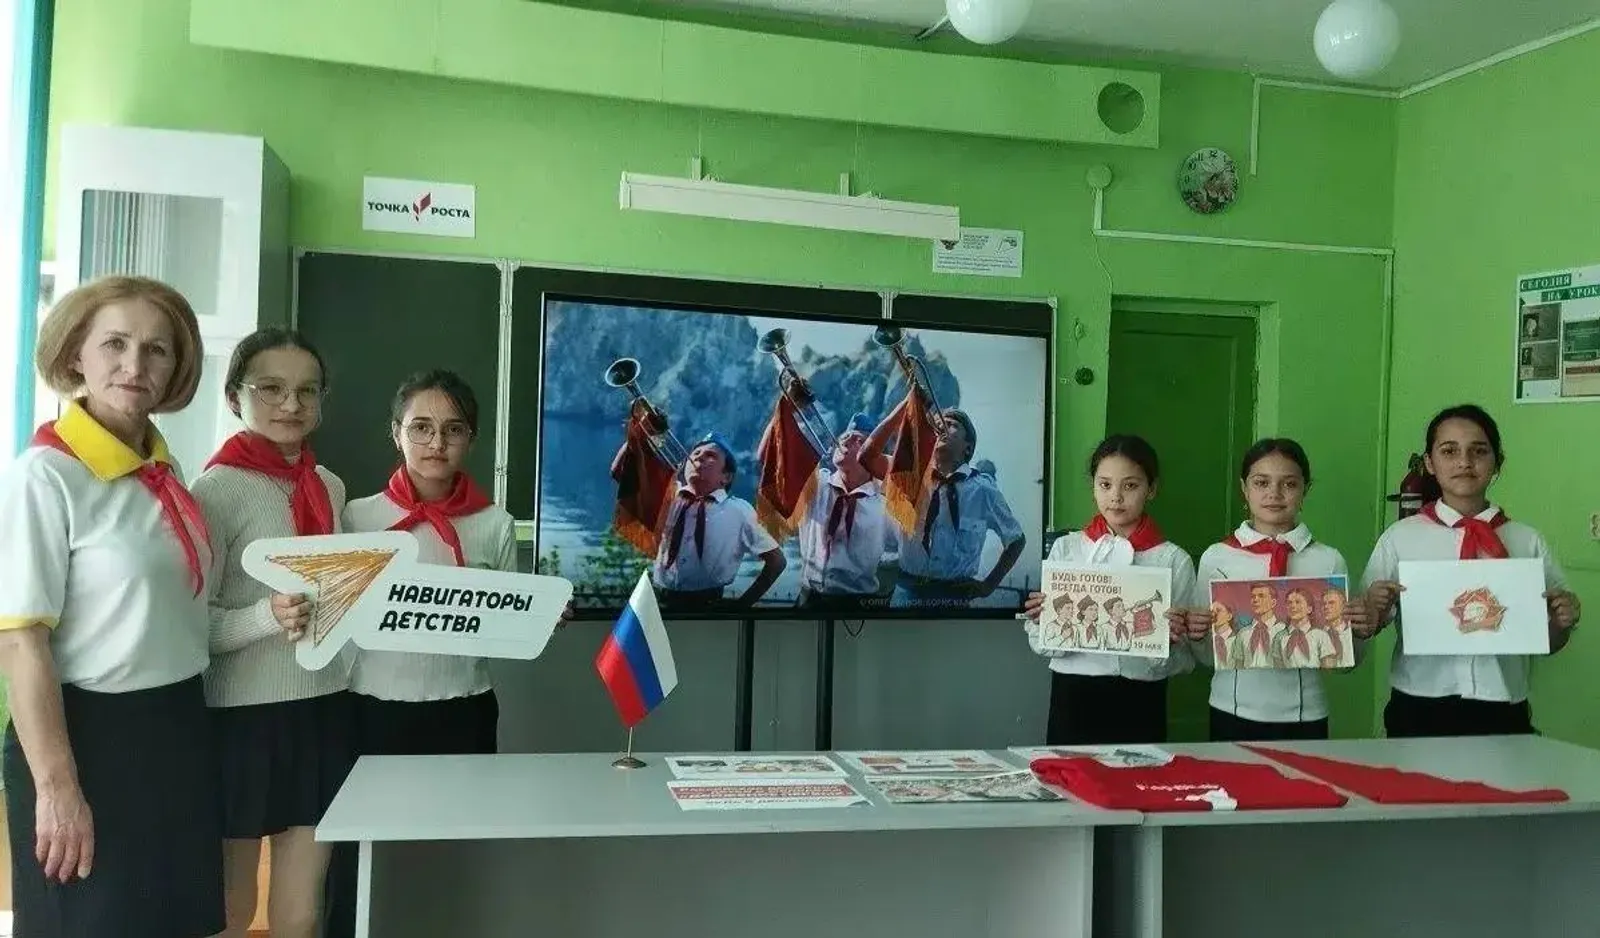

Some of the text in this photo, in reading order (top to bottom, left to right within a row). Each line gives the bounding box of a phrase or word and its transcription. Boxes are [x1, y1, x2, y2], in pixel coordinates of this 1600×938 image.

[367, 201, 470, 218] ТОЧКА РОСТА
[1521, 275, 1570, 290] СЕГОДНЯ
[1052, 572, 1077, 582] БУДЬ
[1052, 583, 1122, 594] ВСЕГДА ГОТОВ!
[388, 584, 533, 611] НАВИГАТОРЫ
[378, 610, 481, 634] ДЕТСТВА
